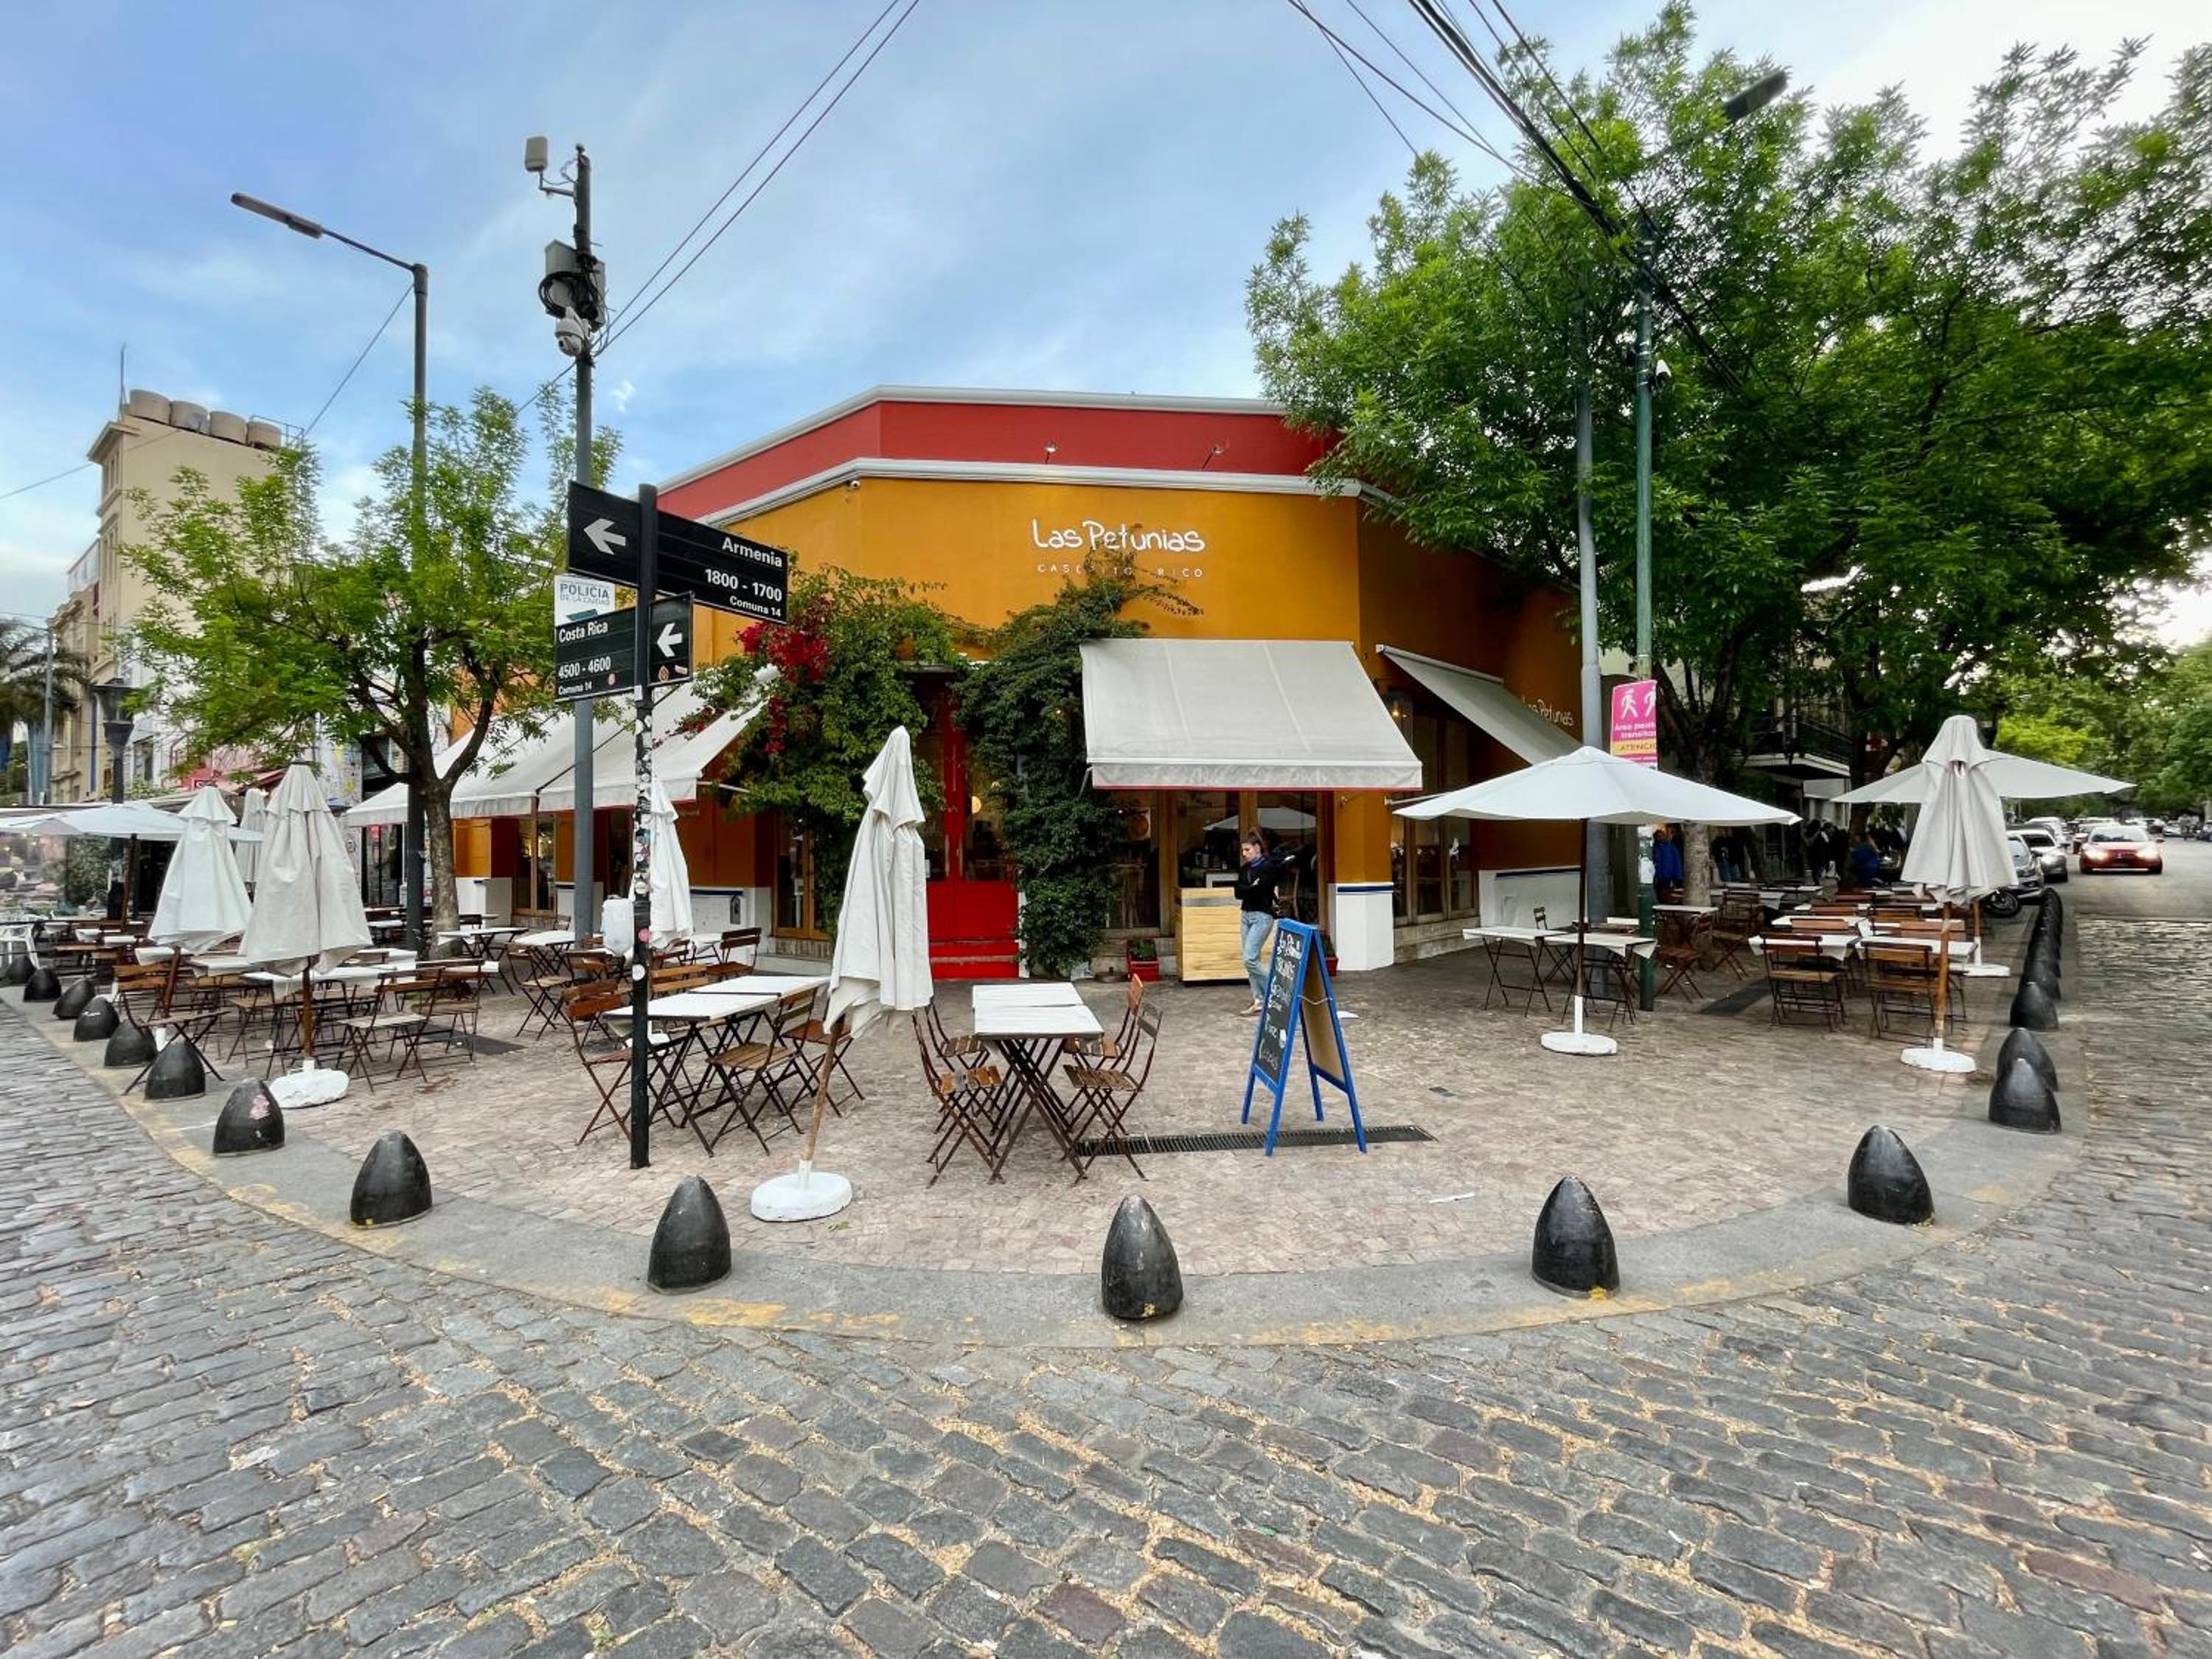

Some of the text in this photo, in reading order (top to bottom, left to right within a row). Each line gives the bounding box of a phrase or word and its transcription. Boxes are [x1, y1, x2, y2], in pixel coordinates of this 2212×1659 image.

[1032, 518, 1206, 552] Las Petunias
[722, 537, 782, 568] Armenia
[705, 568, 739, 589] 1800
[752, 582, 782, 602] 1700
[729, 595, 782, 617] Comuna 14
[558, 621, 608, 643] Costa Rica
[558, 662, 580, 679] 4500
[588, 655, 611, 673] 4600
[558, 681, 593, 695] Comuna 14
